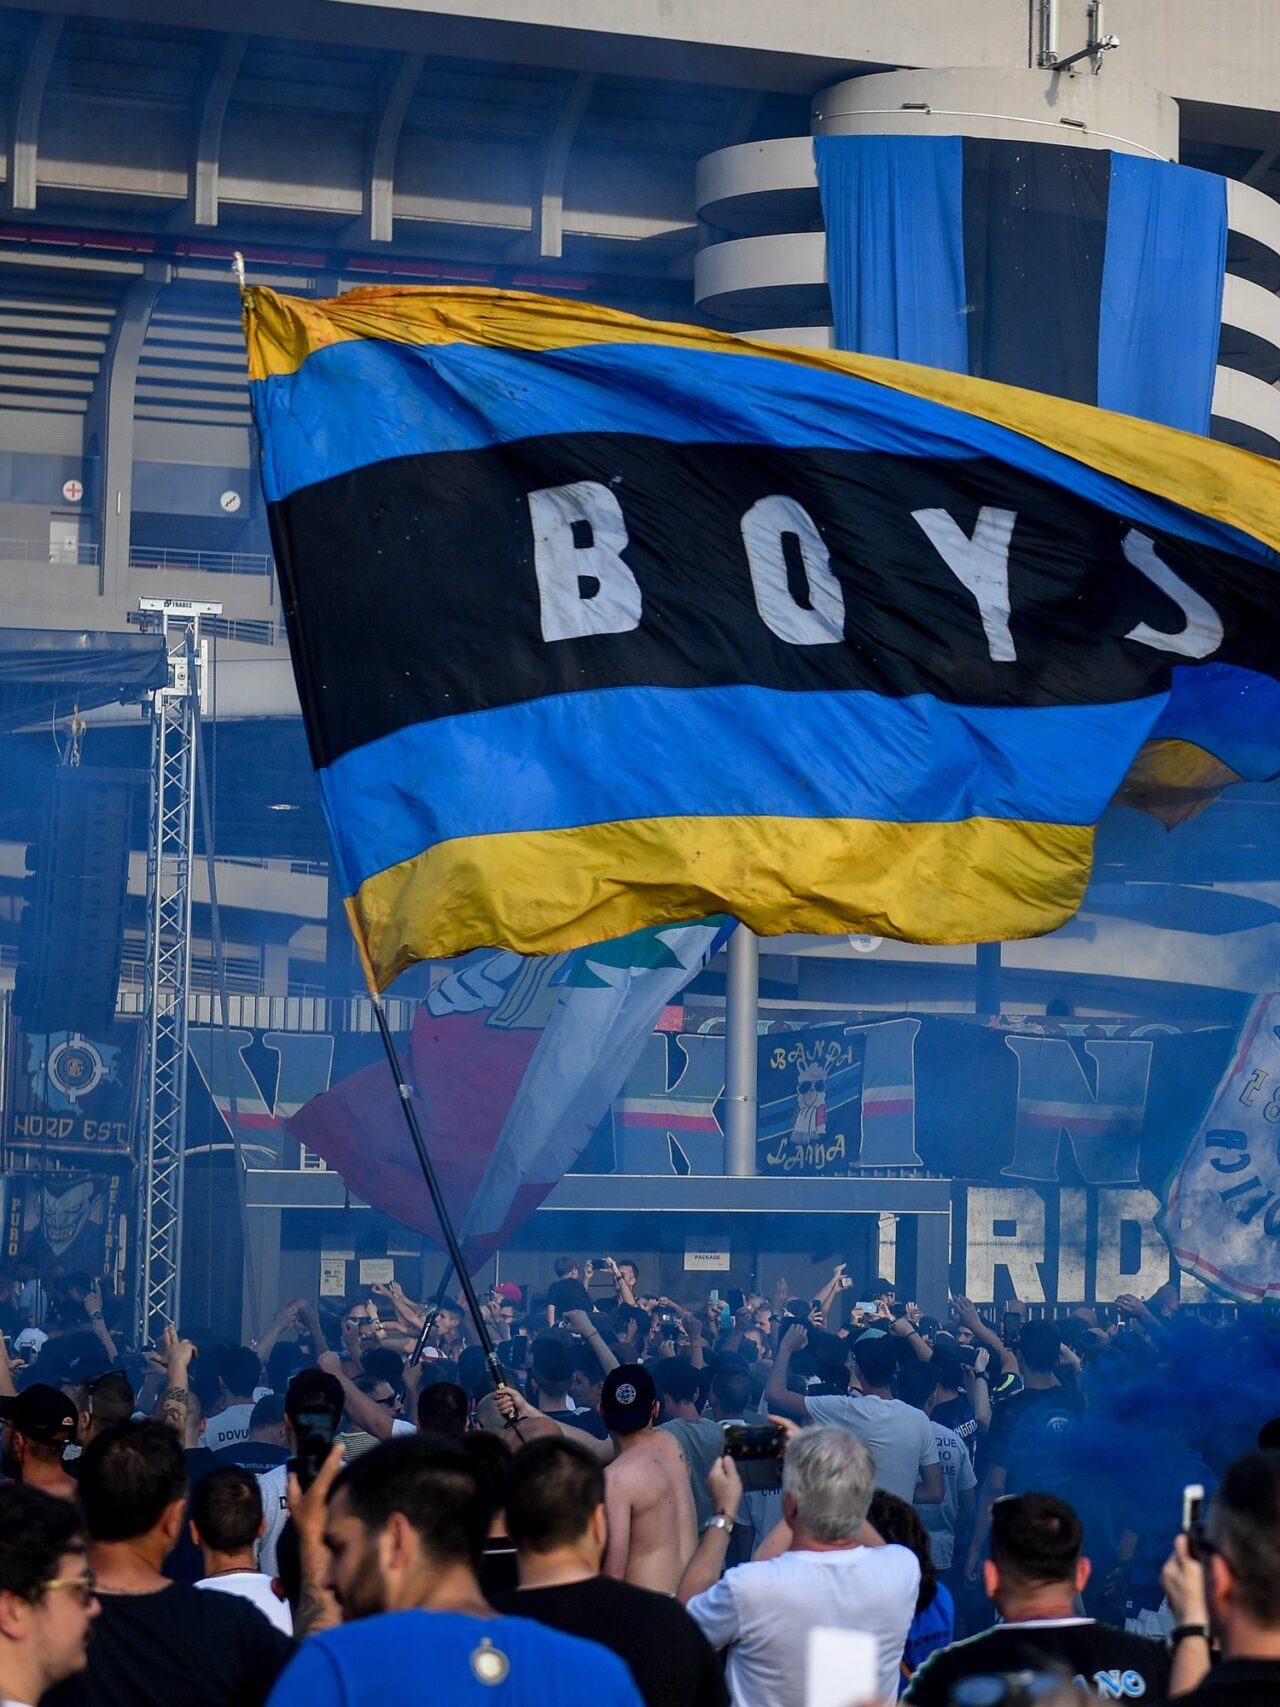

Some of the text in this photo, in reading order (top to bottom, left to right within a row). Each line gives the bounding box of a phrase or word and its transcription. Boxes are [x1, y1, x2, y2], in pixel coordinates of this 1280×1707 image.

[527, 480, 1225, 662] BOYS
[770, 1040, 854, 1070] BANDA
[13, 1116, 127, 1144] NORD EST
[765, 1134, 847, 1172] LAMA
[8, 1198, 21, 1257] PURO
[218, 1429, 249, 1442] DOVU
